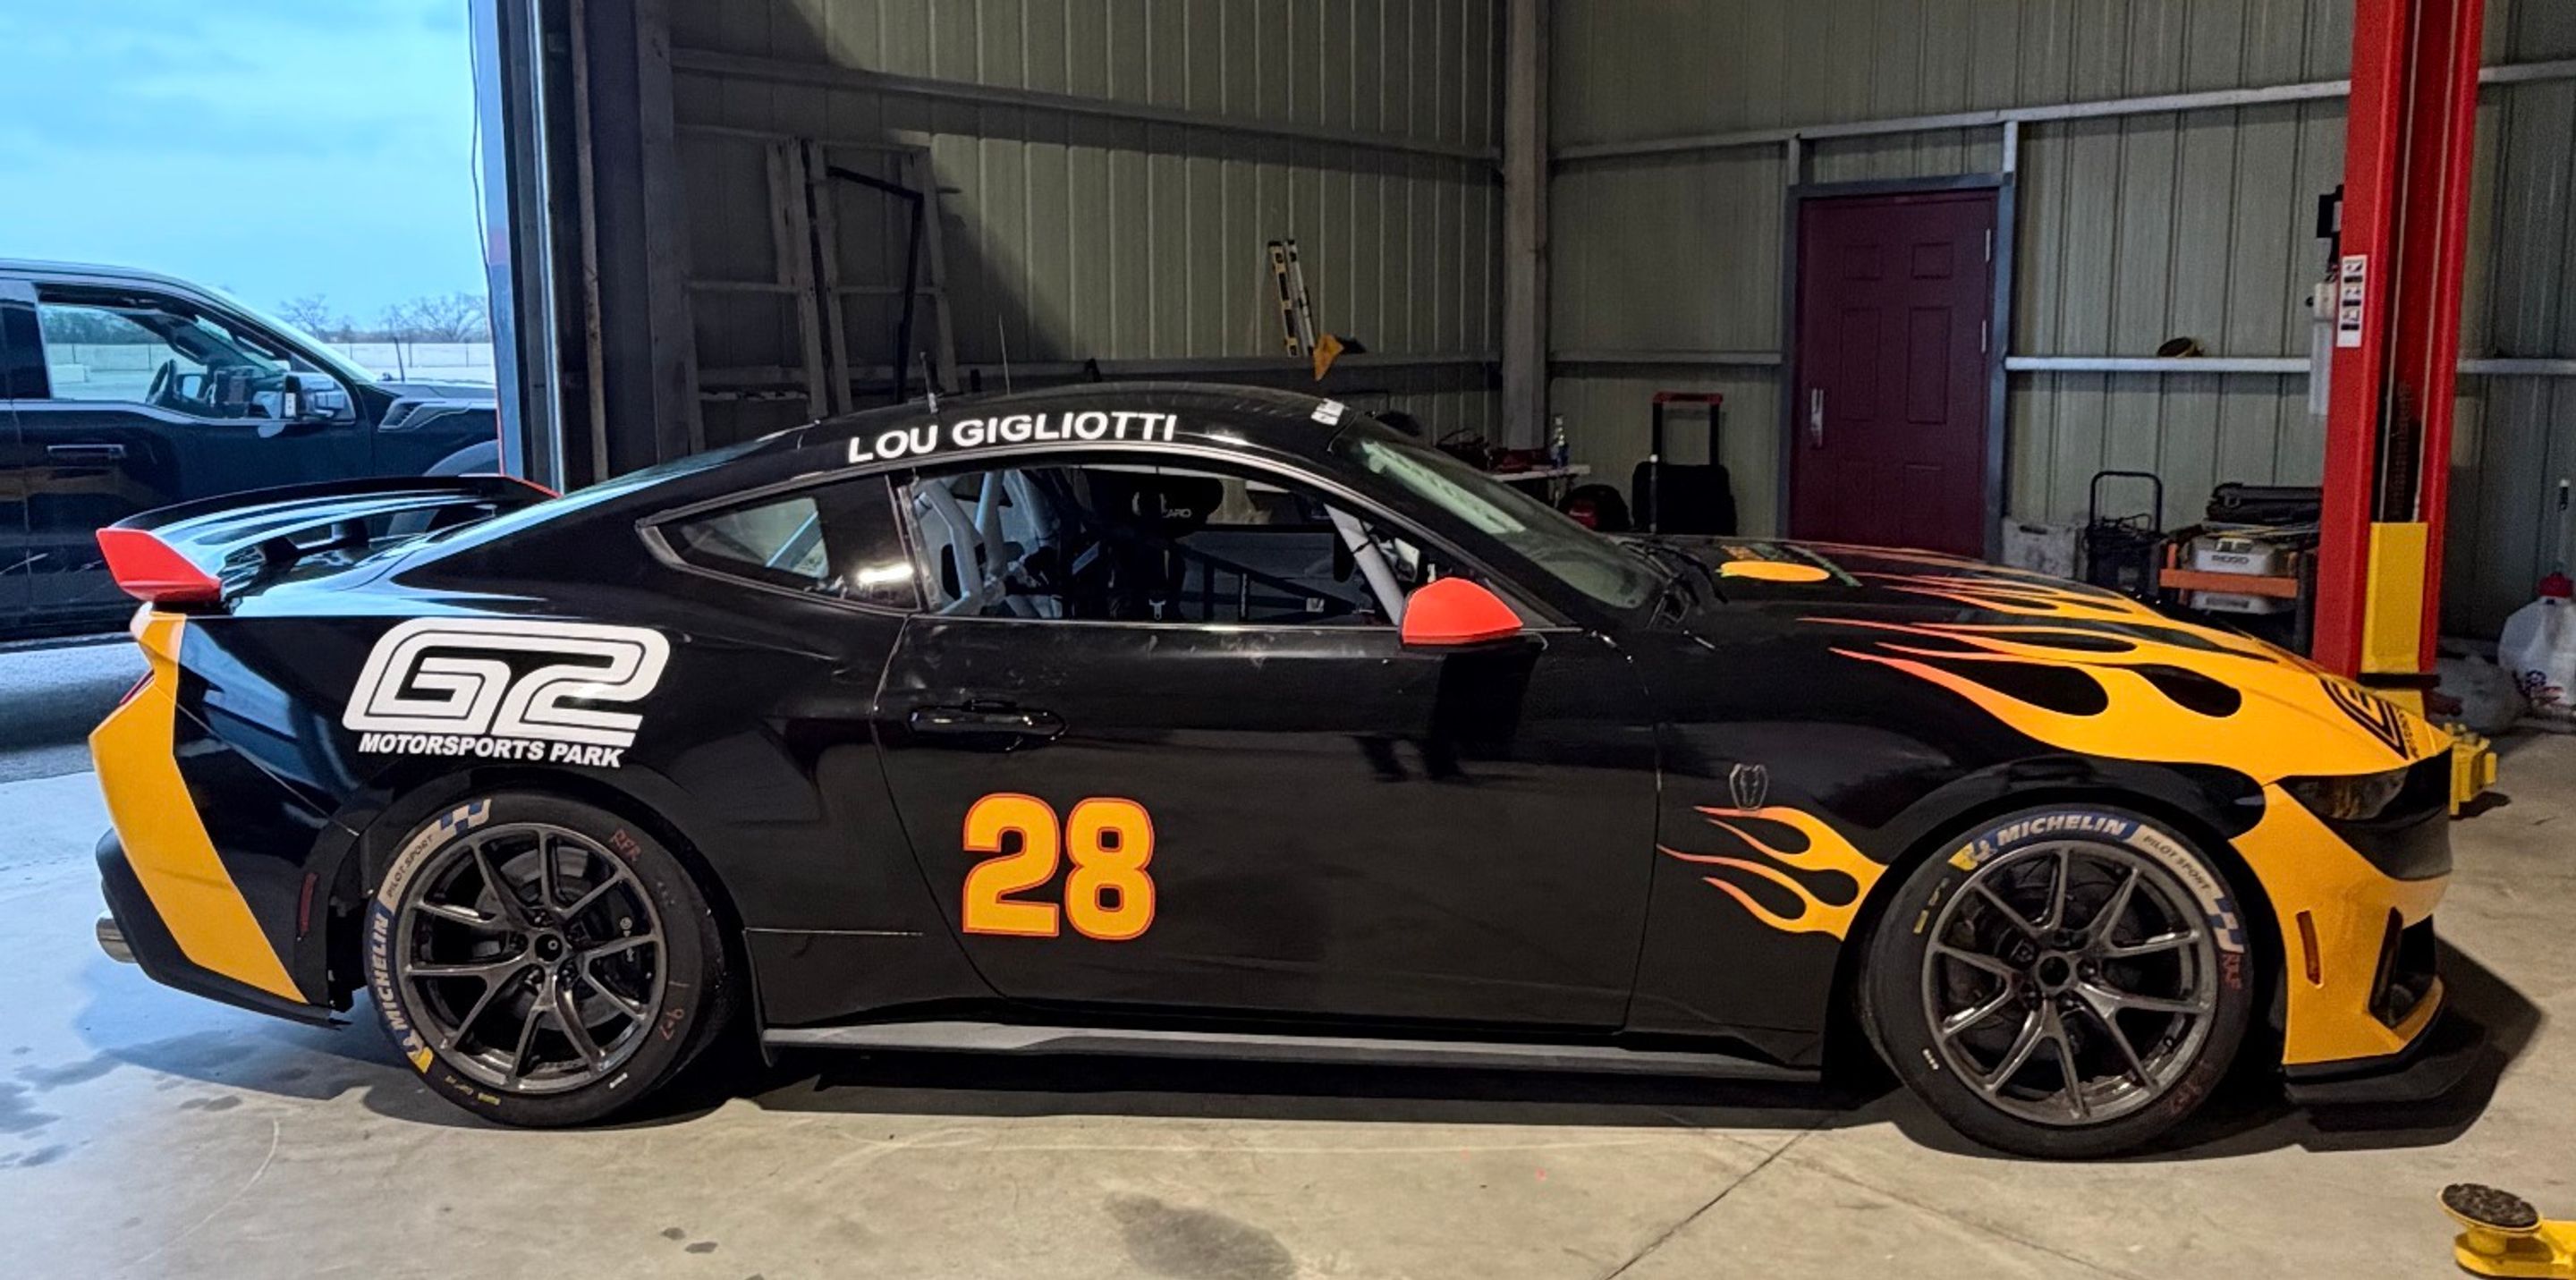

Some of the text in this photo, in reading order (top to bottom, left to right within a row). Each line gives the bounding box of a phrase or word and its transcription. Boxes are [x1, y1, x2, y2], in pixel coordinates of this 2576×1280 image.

[848, 411, 1177, 463] LOU GIGLIOTTI
[342, 617, 671, 747] G2
[359, 733, 624, 768] MOTORSPORTS PARK
[1996, 815, 2127, 846] MICHELIN
[386, 835, 433, 897] PILOT SPORT
[962, 793, 1157, 941] 28
[2143, 835, 2210, 889] PILOT SPORT
[371, 912, 408, 1030] MICHELIN
